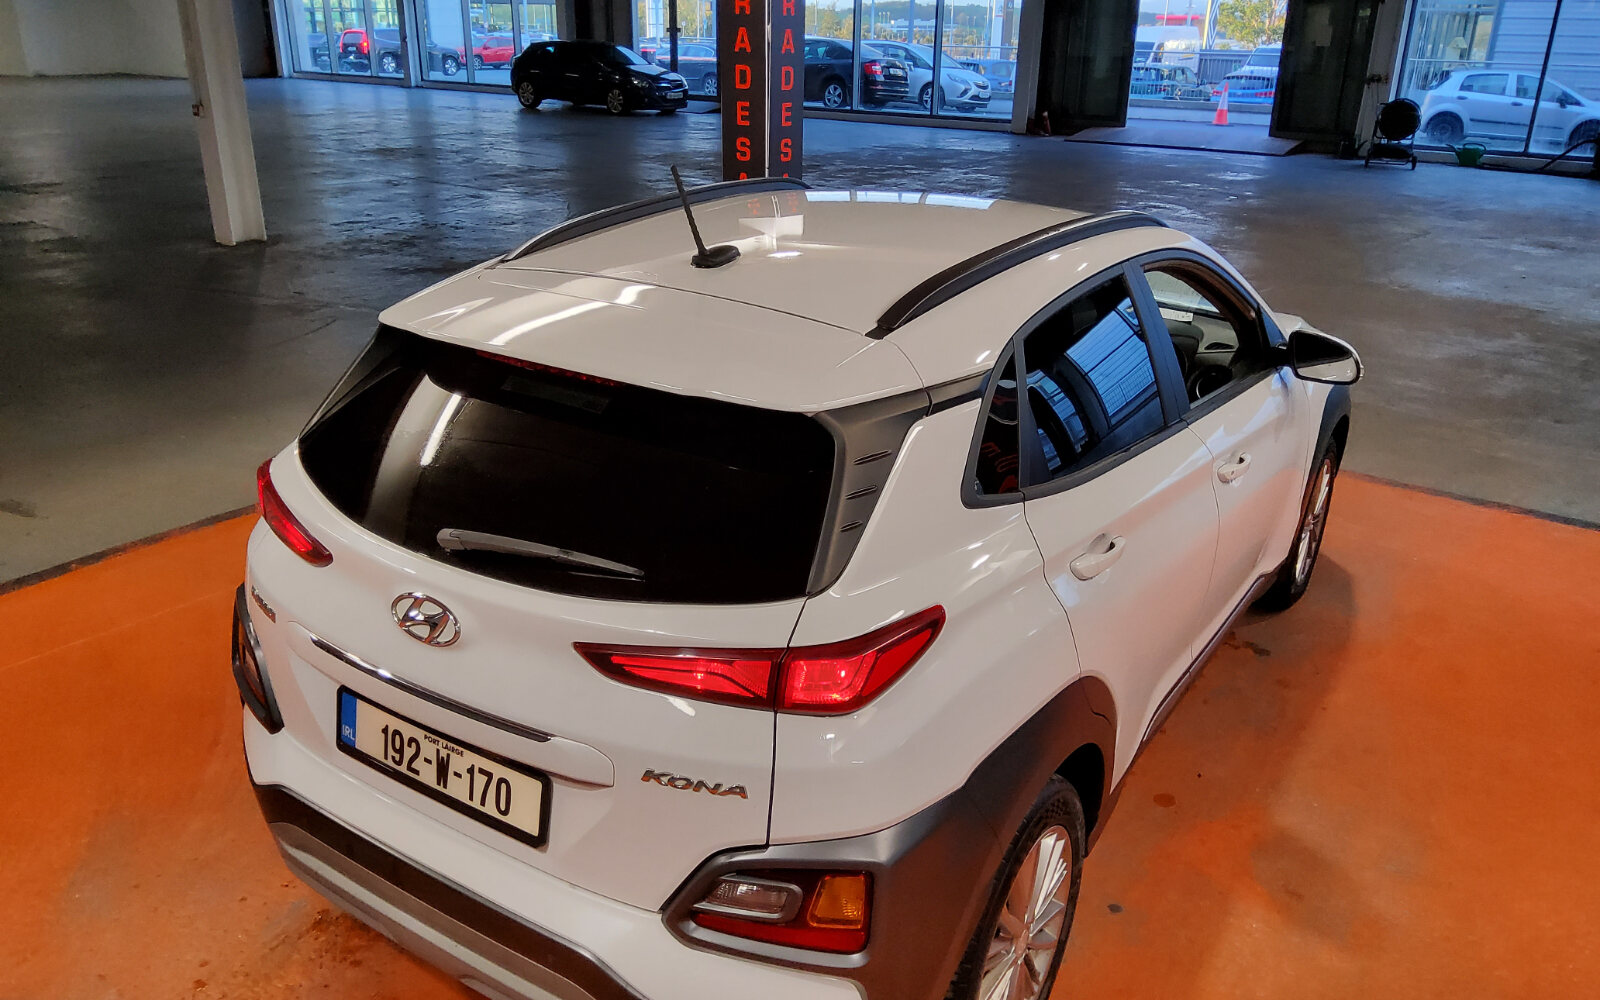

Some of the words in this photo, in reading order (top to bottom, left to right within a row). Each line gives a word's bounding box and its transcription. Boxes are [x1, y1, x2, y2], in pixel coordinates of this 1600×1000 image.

[342, 724, 355, 740] IRL
[424, 734, 440, 747] PORT
[382, 724, 511, 817] 192-W-170
[641, 768, 748, 799] KONA
